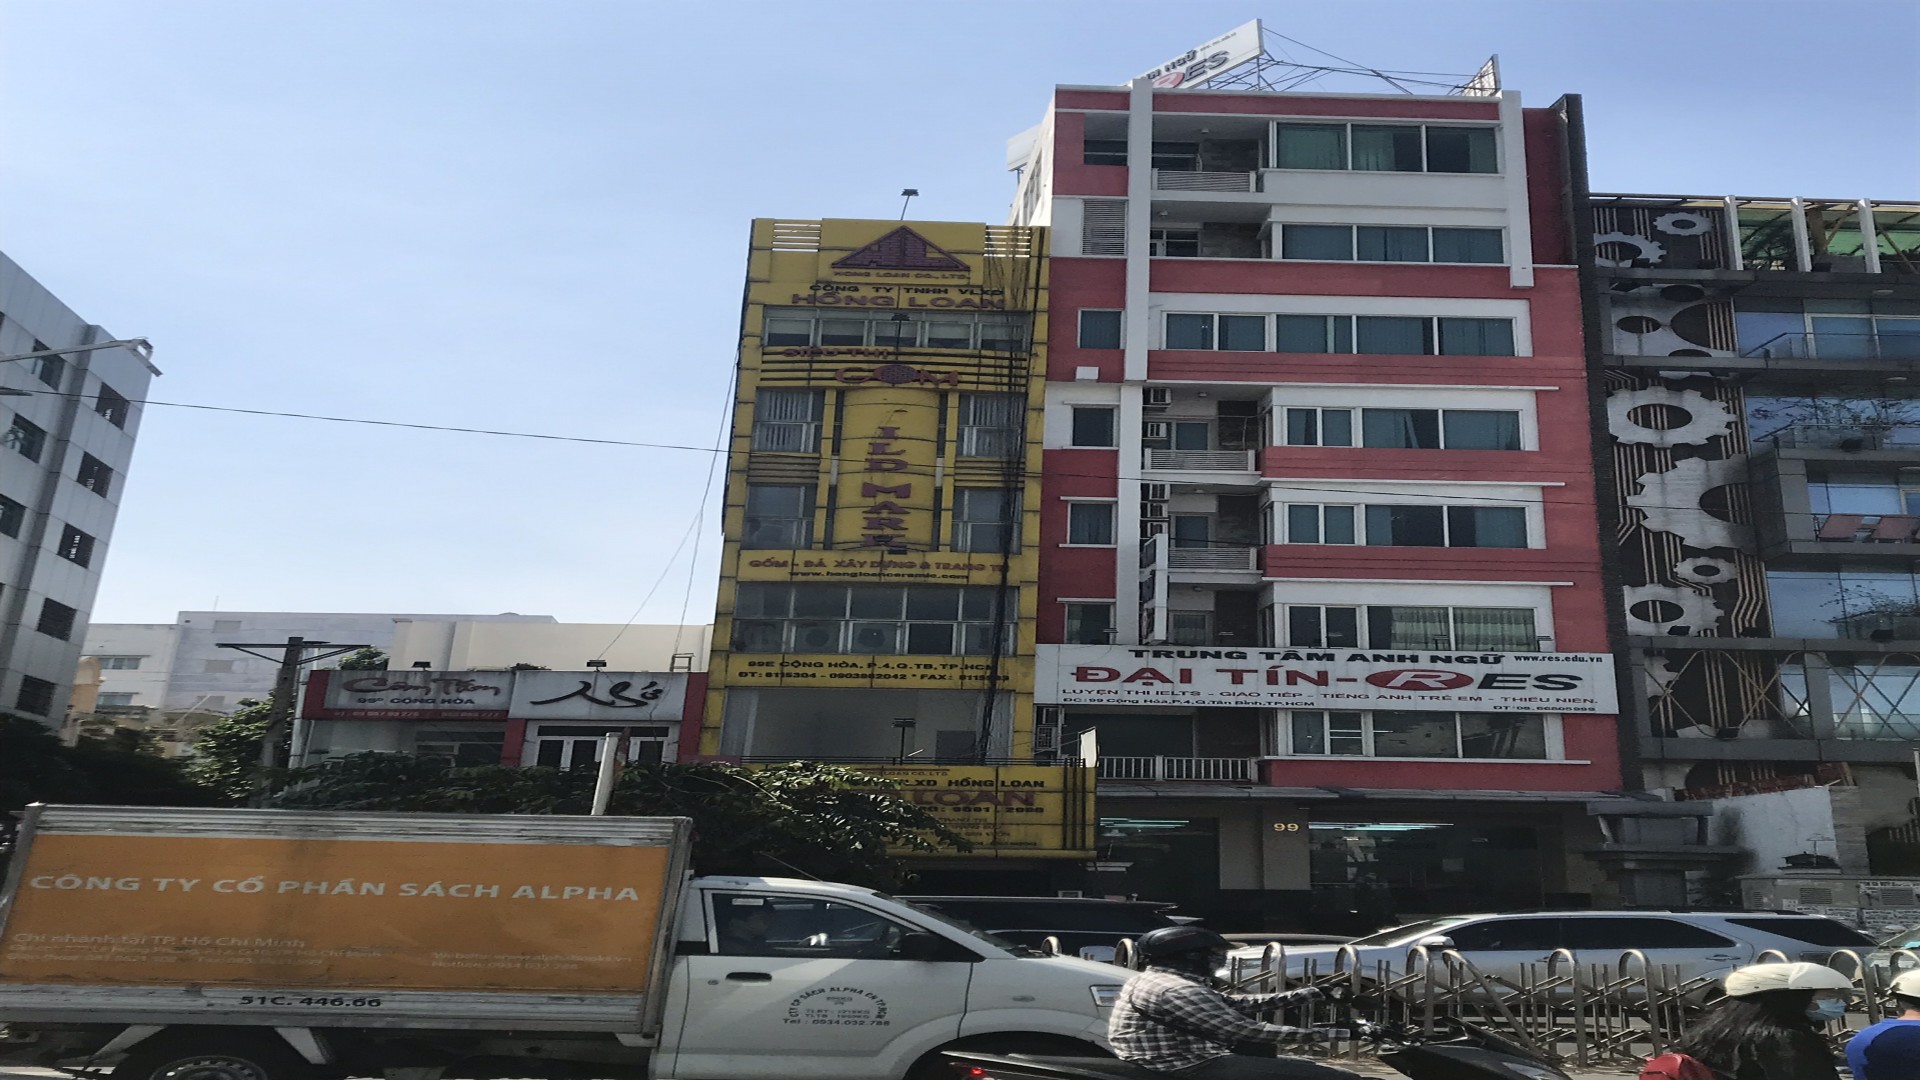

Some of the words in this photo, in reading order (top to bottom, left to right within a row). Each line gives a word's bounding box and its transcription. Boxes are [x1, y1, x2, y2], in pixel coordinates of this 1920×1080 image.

[809, 283, 860, 292] CÔNG
[791, 291, 895, 307] HỒNG
[908, 296, 1005, 309] LOAN
[749, 556, 789, 568] GỐM
[833, 559, 869, 569] XÂY
[870, 560, 917, 571] DỰNG
[935, 562, 985, 571] TRANG
[1128, 649, 1248, 660] TRUNG
[1258, 650, 1336, 662] TÂM
[1346, 653, 1419, 664] ANH
[1430, 653, 1506, 665] NGỮ
[1513, 654, 1603, 663] www.res.edu.vn
[779, 660, 824, 669] CỘNG
[1069, 665, 1192, 687] ĐẠI
[1061, 688, 1119, 697] LUYỆN
[389, 697, 437, 705] CỘNG
[947, 777, 995, 787] HỒNG
[1000, 779, 1045, 788] LOAN
[912, 791, 1036, 806] LOAN
[1273, 822, 1300, 832] 99
[29, 873, 141, 892] CÔNG
[152, 878, 201, 893] TY
[398, 880, 501, 899] SÁCH
[511, 884, 640, 901] ALPHA
[255, 938, 305, 948] Minh
[829, 986, 864, 995] ALPHA
[298, 996, 383, 1008] 446.66
